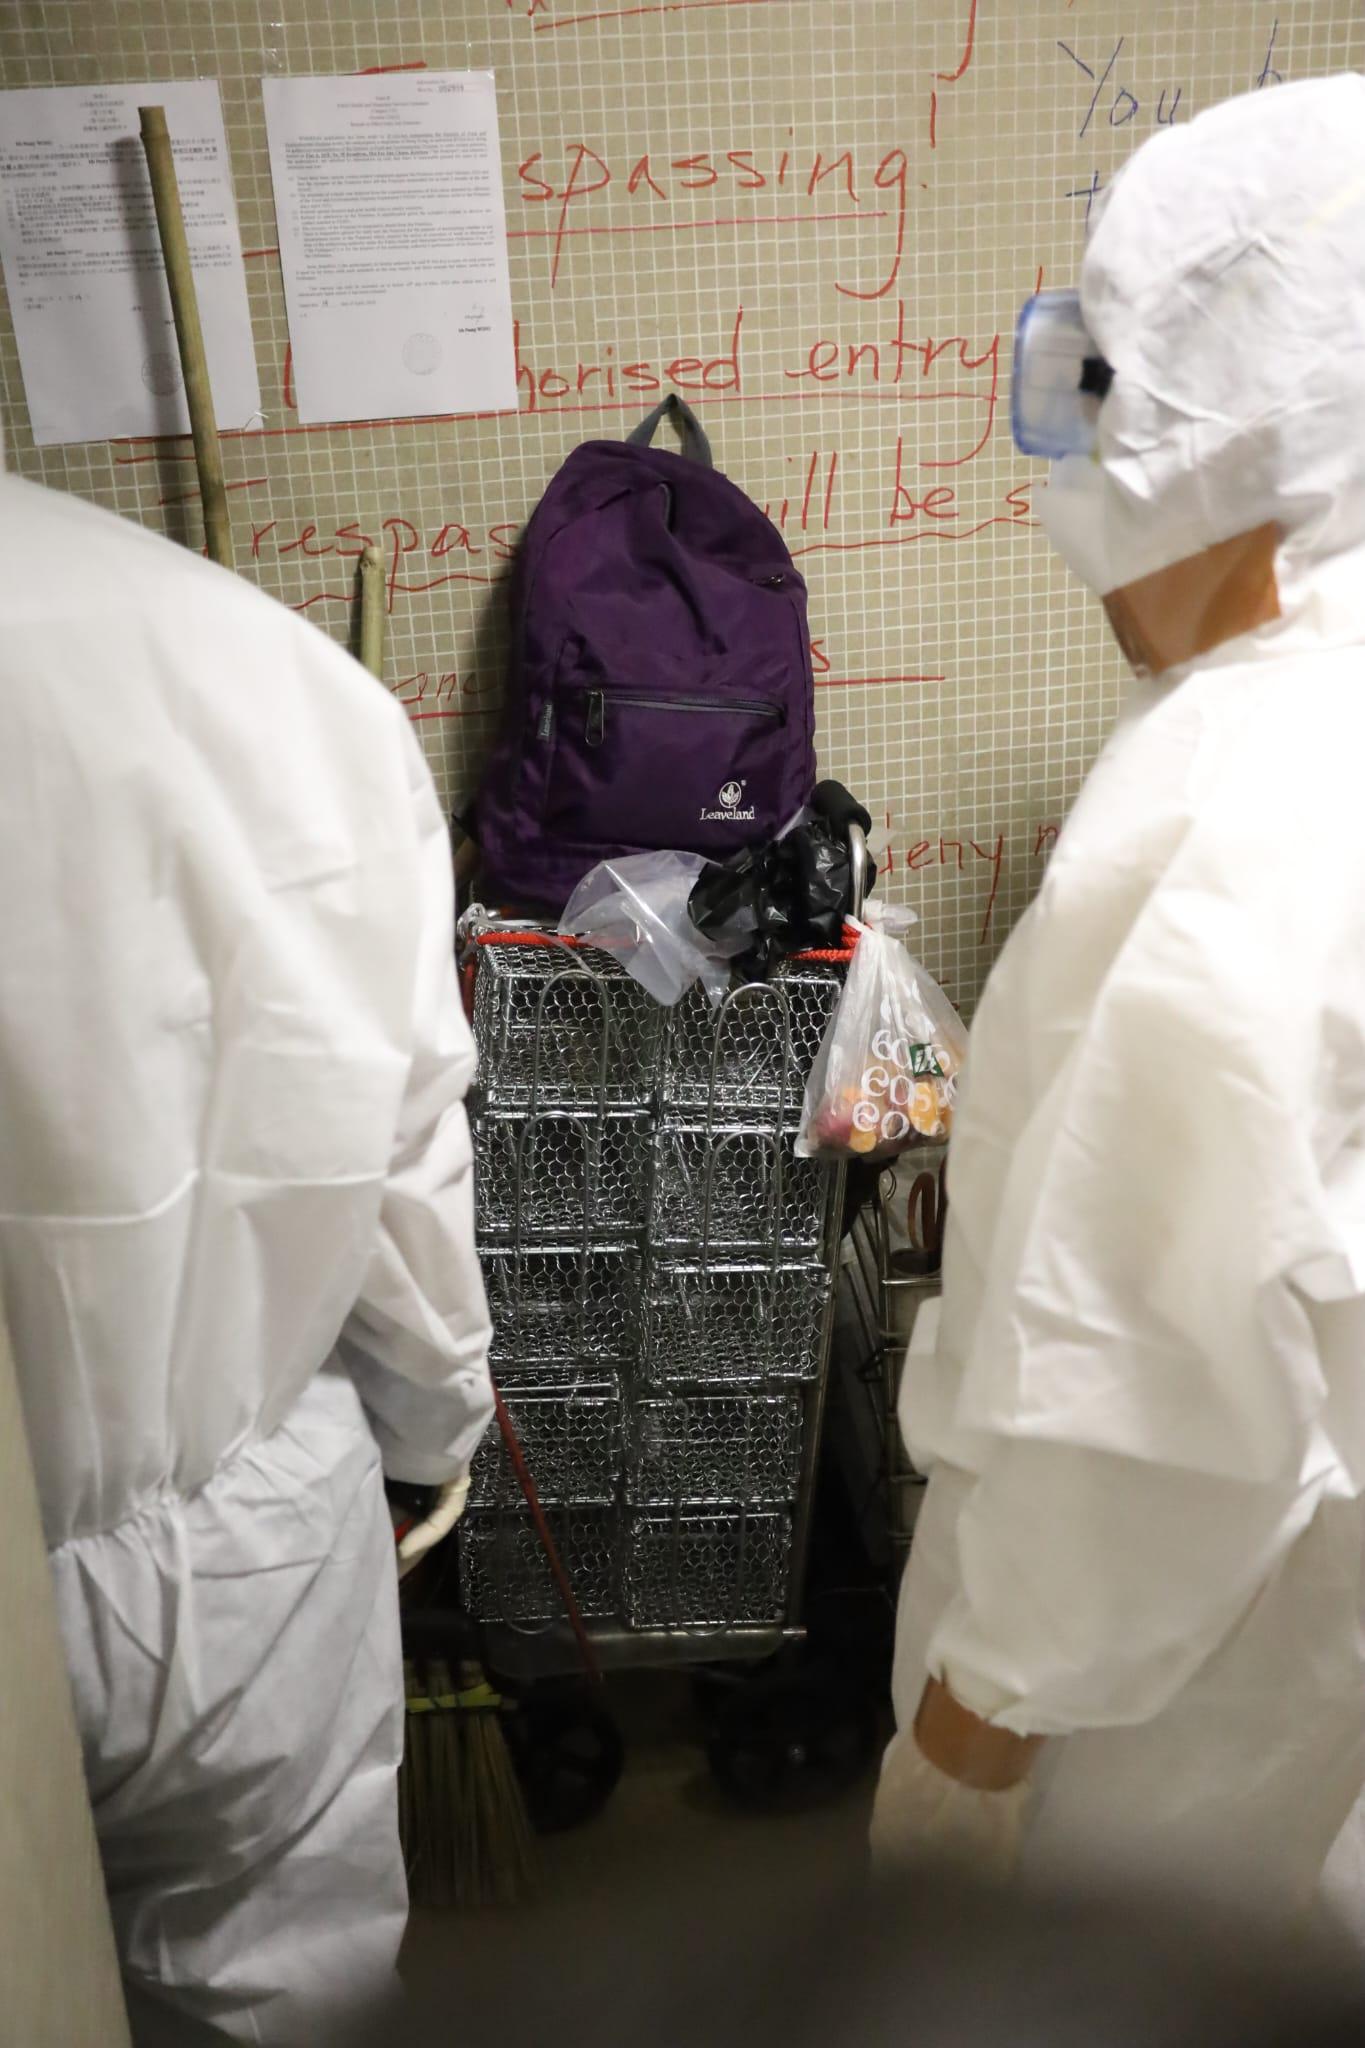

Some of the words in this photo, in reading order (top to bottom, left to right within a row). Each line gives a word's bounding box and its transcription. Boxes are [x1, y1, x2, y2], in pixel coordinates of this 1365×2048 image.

[1057, 37, 1182, 138] You
[513, 303, 743, 412] horised
[785, 300, 1000, 467] entry
[765, 451, 838, 530] ill
[889, 436, 960, 528] be
[699, 805, 756, 821] Leaveland
